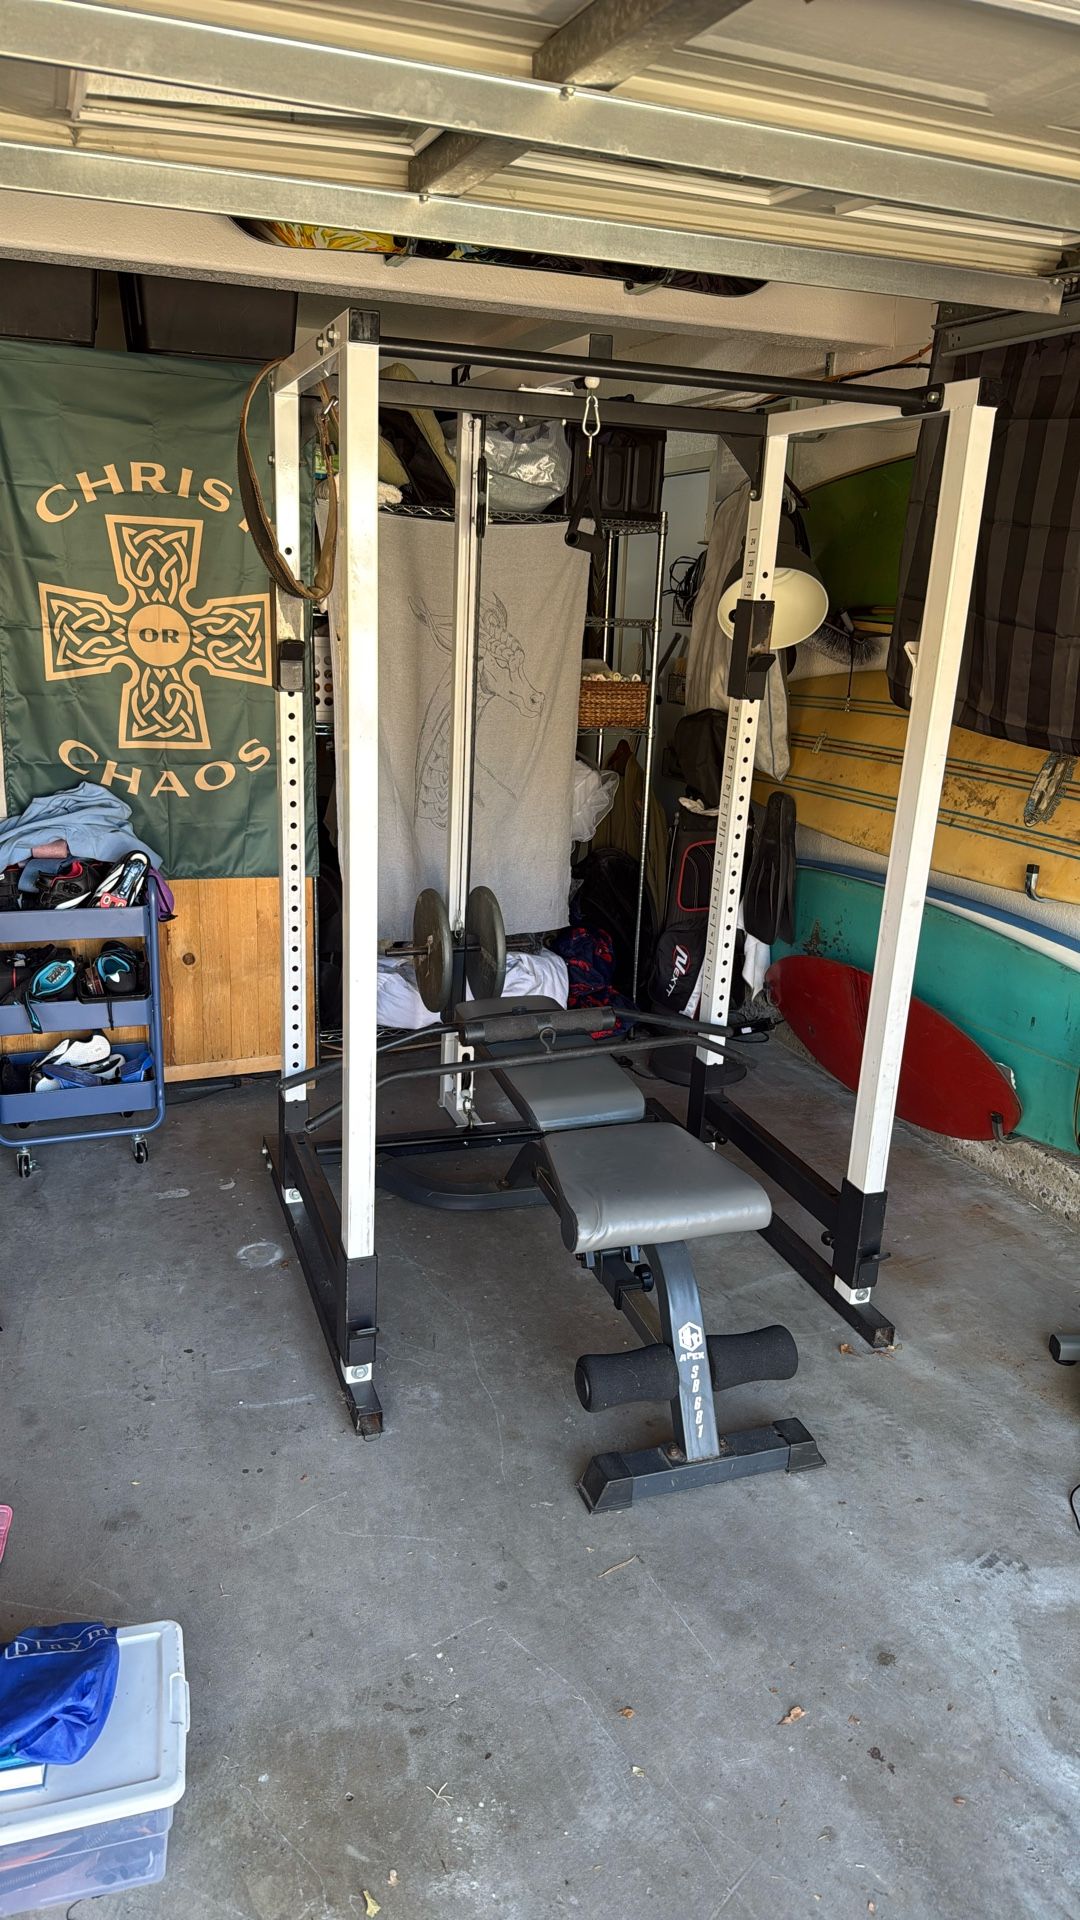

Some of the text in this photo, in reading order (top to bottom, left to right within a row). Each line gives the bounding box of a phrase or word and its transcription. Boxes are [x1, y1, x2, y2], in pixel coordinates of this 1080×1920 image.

[35, 461, 271, 532] CHRIS
[139, 628, 180, 645] OR
[58, 738, 271, 798] CHAOS
[679, 1351, 705, 1362] APEX
